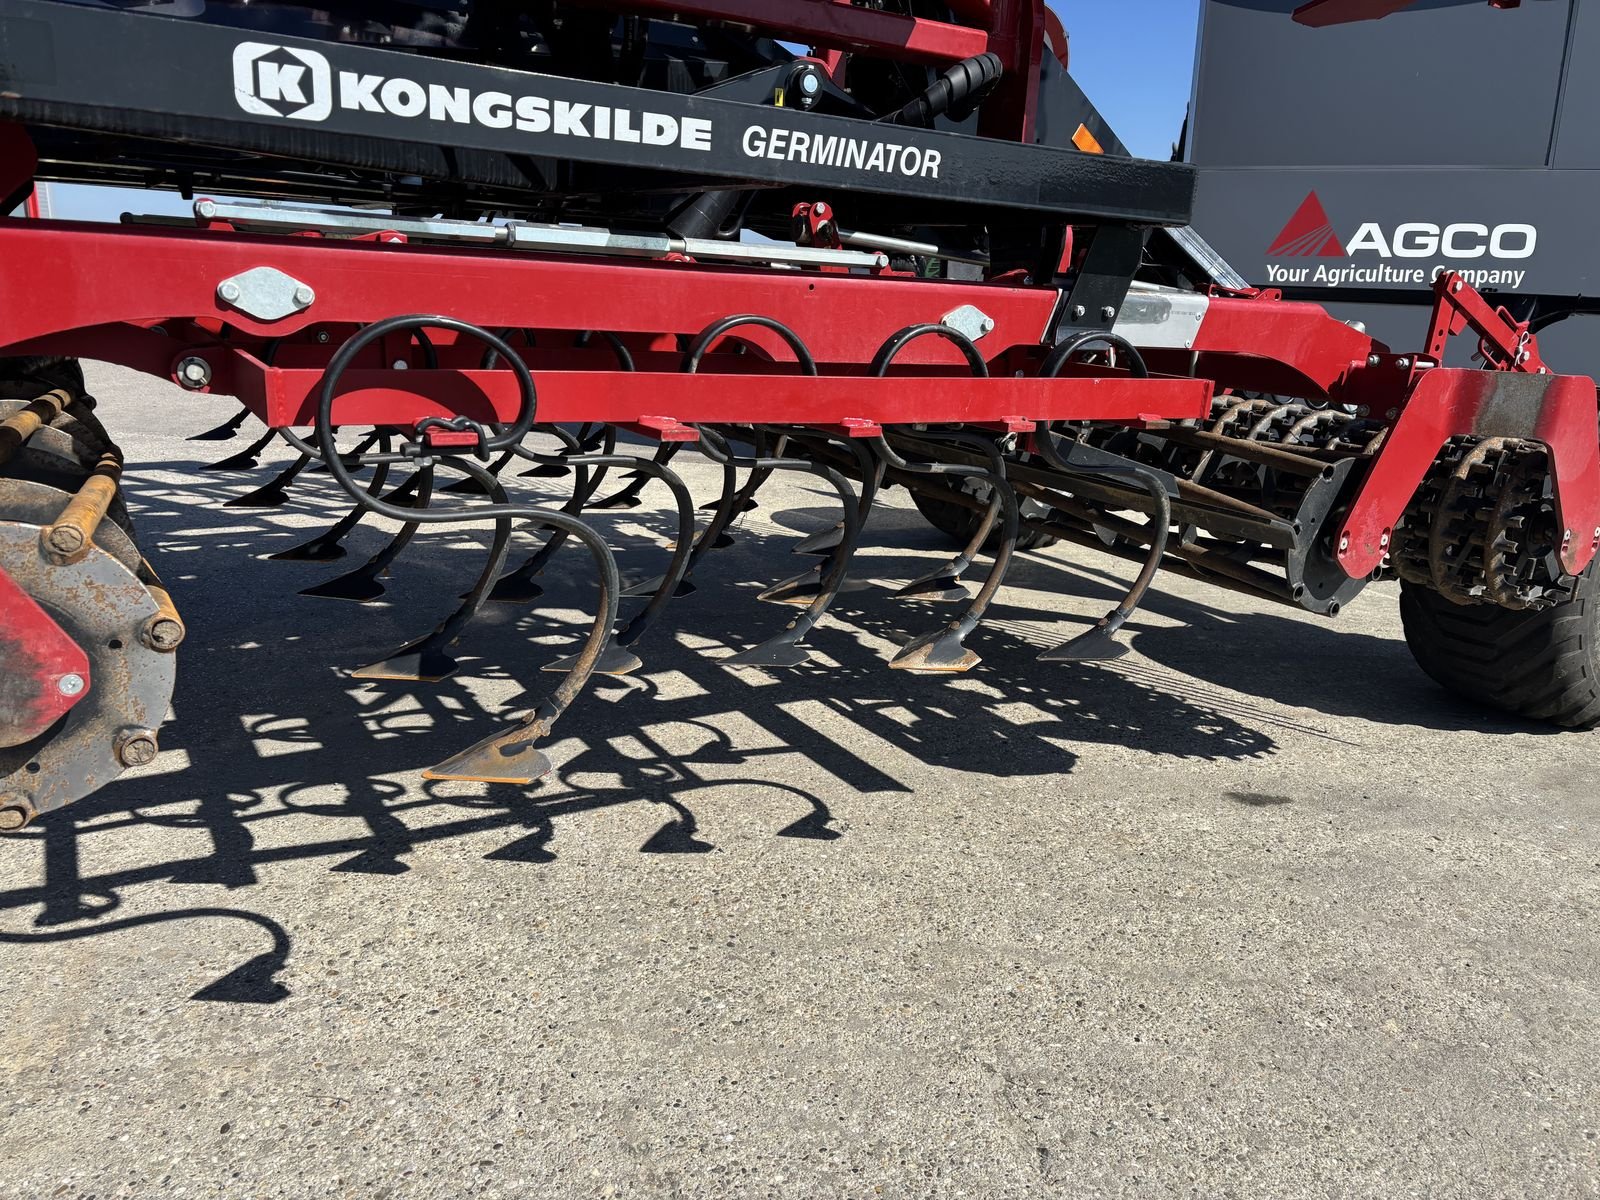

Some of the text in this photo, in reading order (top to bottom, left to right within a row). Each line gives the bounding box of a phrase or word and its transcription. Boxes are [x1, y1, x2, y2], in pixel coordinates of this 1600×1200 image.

[257, 60, 308, 104] K
[339, 70, 713, 152] KONGSKILDE
[742, 125, 942, 179] GERMINATOR
[1345, 222, 1537, 259] AGCO
[1266, 263, 1526, 289] Your Agriculture Cmpany
